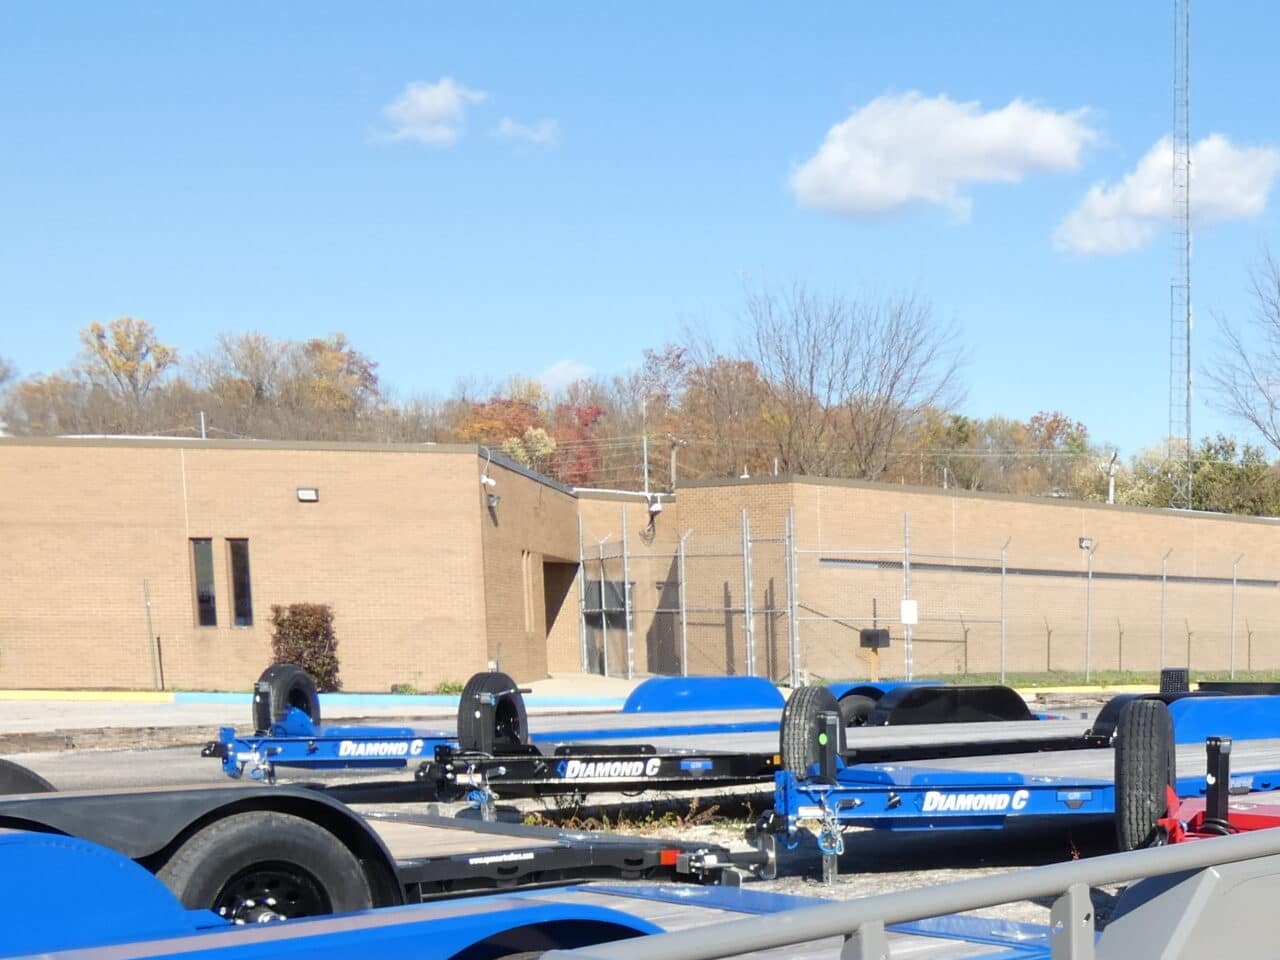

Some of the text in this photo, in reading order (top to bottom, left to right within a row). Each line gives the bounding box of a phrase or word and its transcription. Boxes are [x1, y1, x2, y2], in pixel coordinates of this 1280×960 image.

[338, 738, 425, 757] DIAMOND C
[565, 758, 661, 778] DIAMOND C
[922, 789, 1030, 812] DIAMOND C
